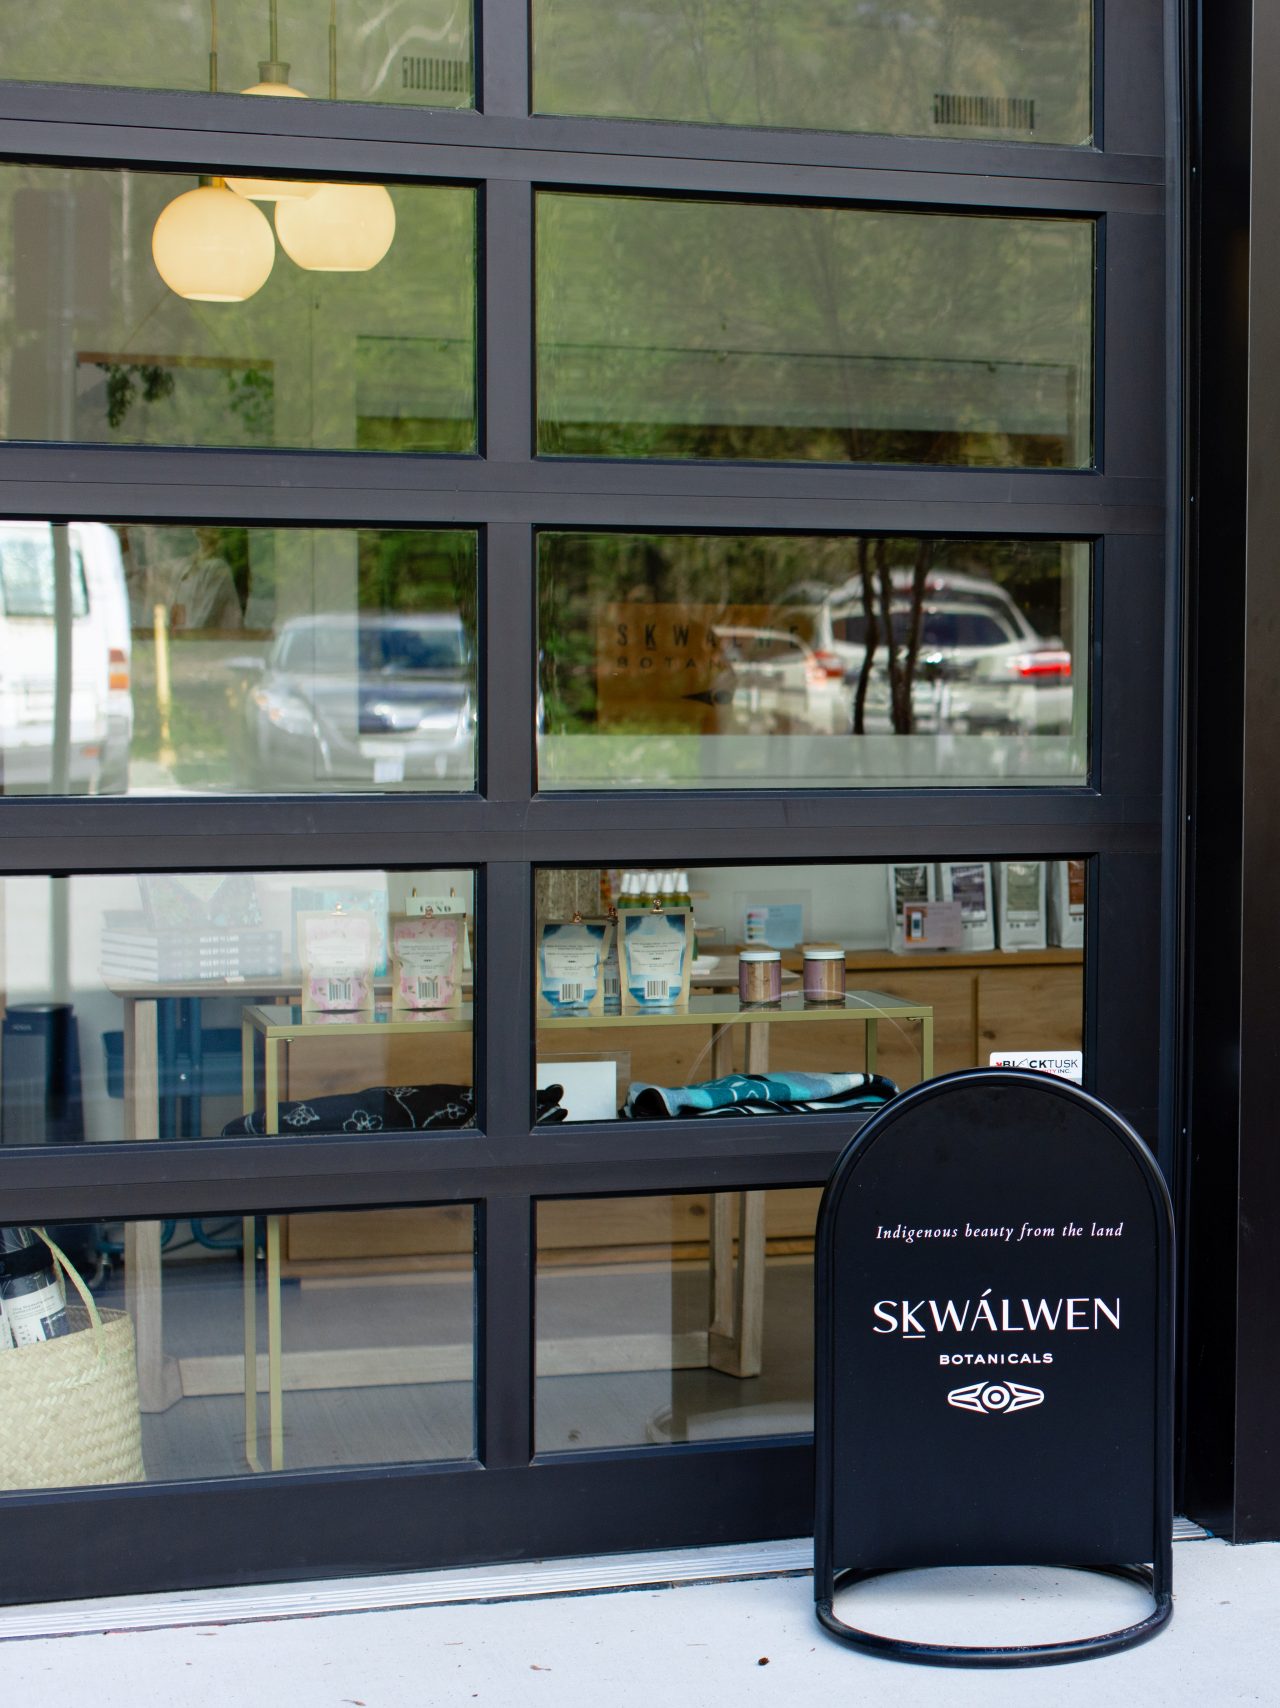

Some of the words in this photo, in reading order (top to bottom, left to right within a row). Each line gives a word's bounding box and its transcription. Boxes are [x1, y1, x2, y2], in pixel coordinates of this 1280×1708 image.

[876, 1224, 958, 1243] Indigenous
[965, 1223, 1014, 1241] beauty
[1016, 1222, 1055, 1242] from
[1062, 1223, 1083, 1237] the
[1091, 1222, 1124, 1237] land
[939, 1353, 1054, 1365] BOTANICALS
